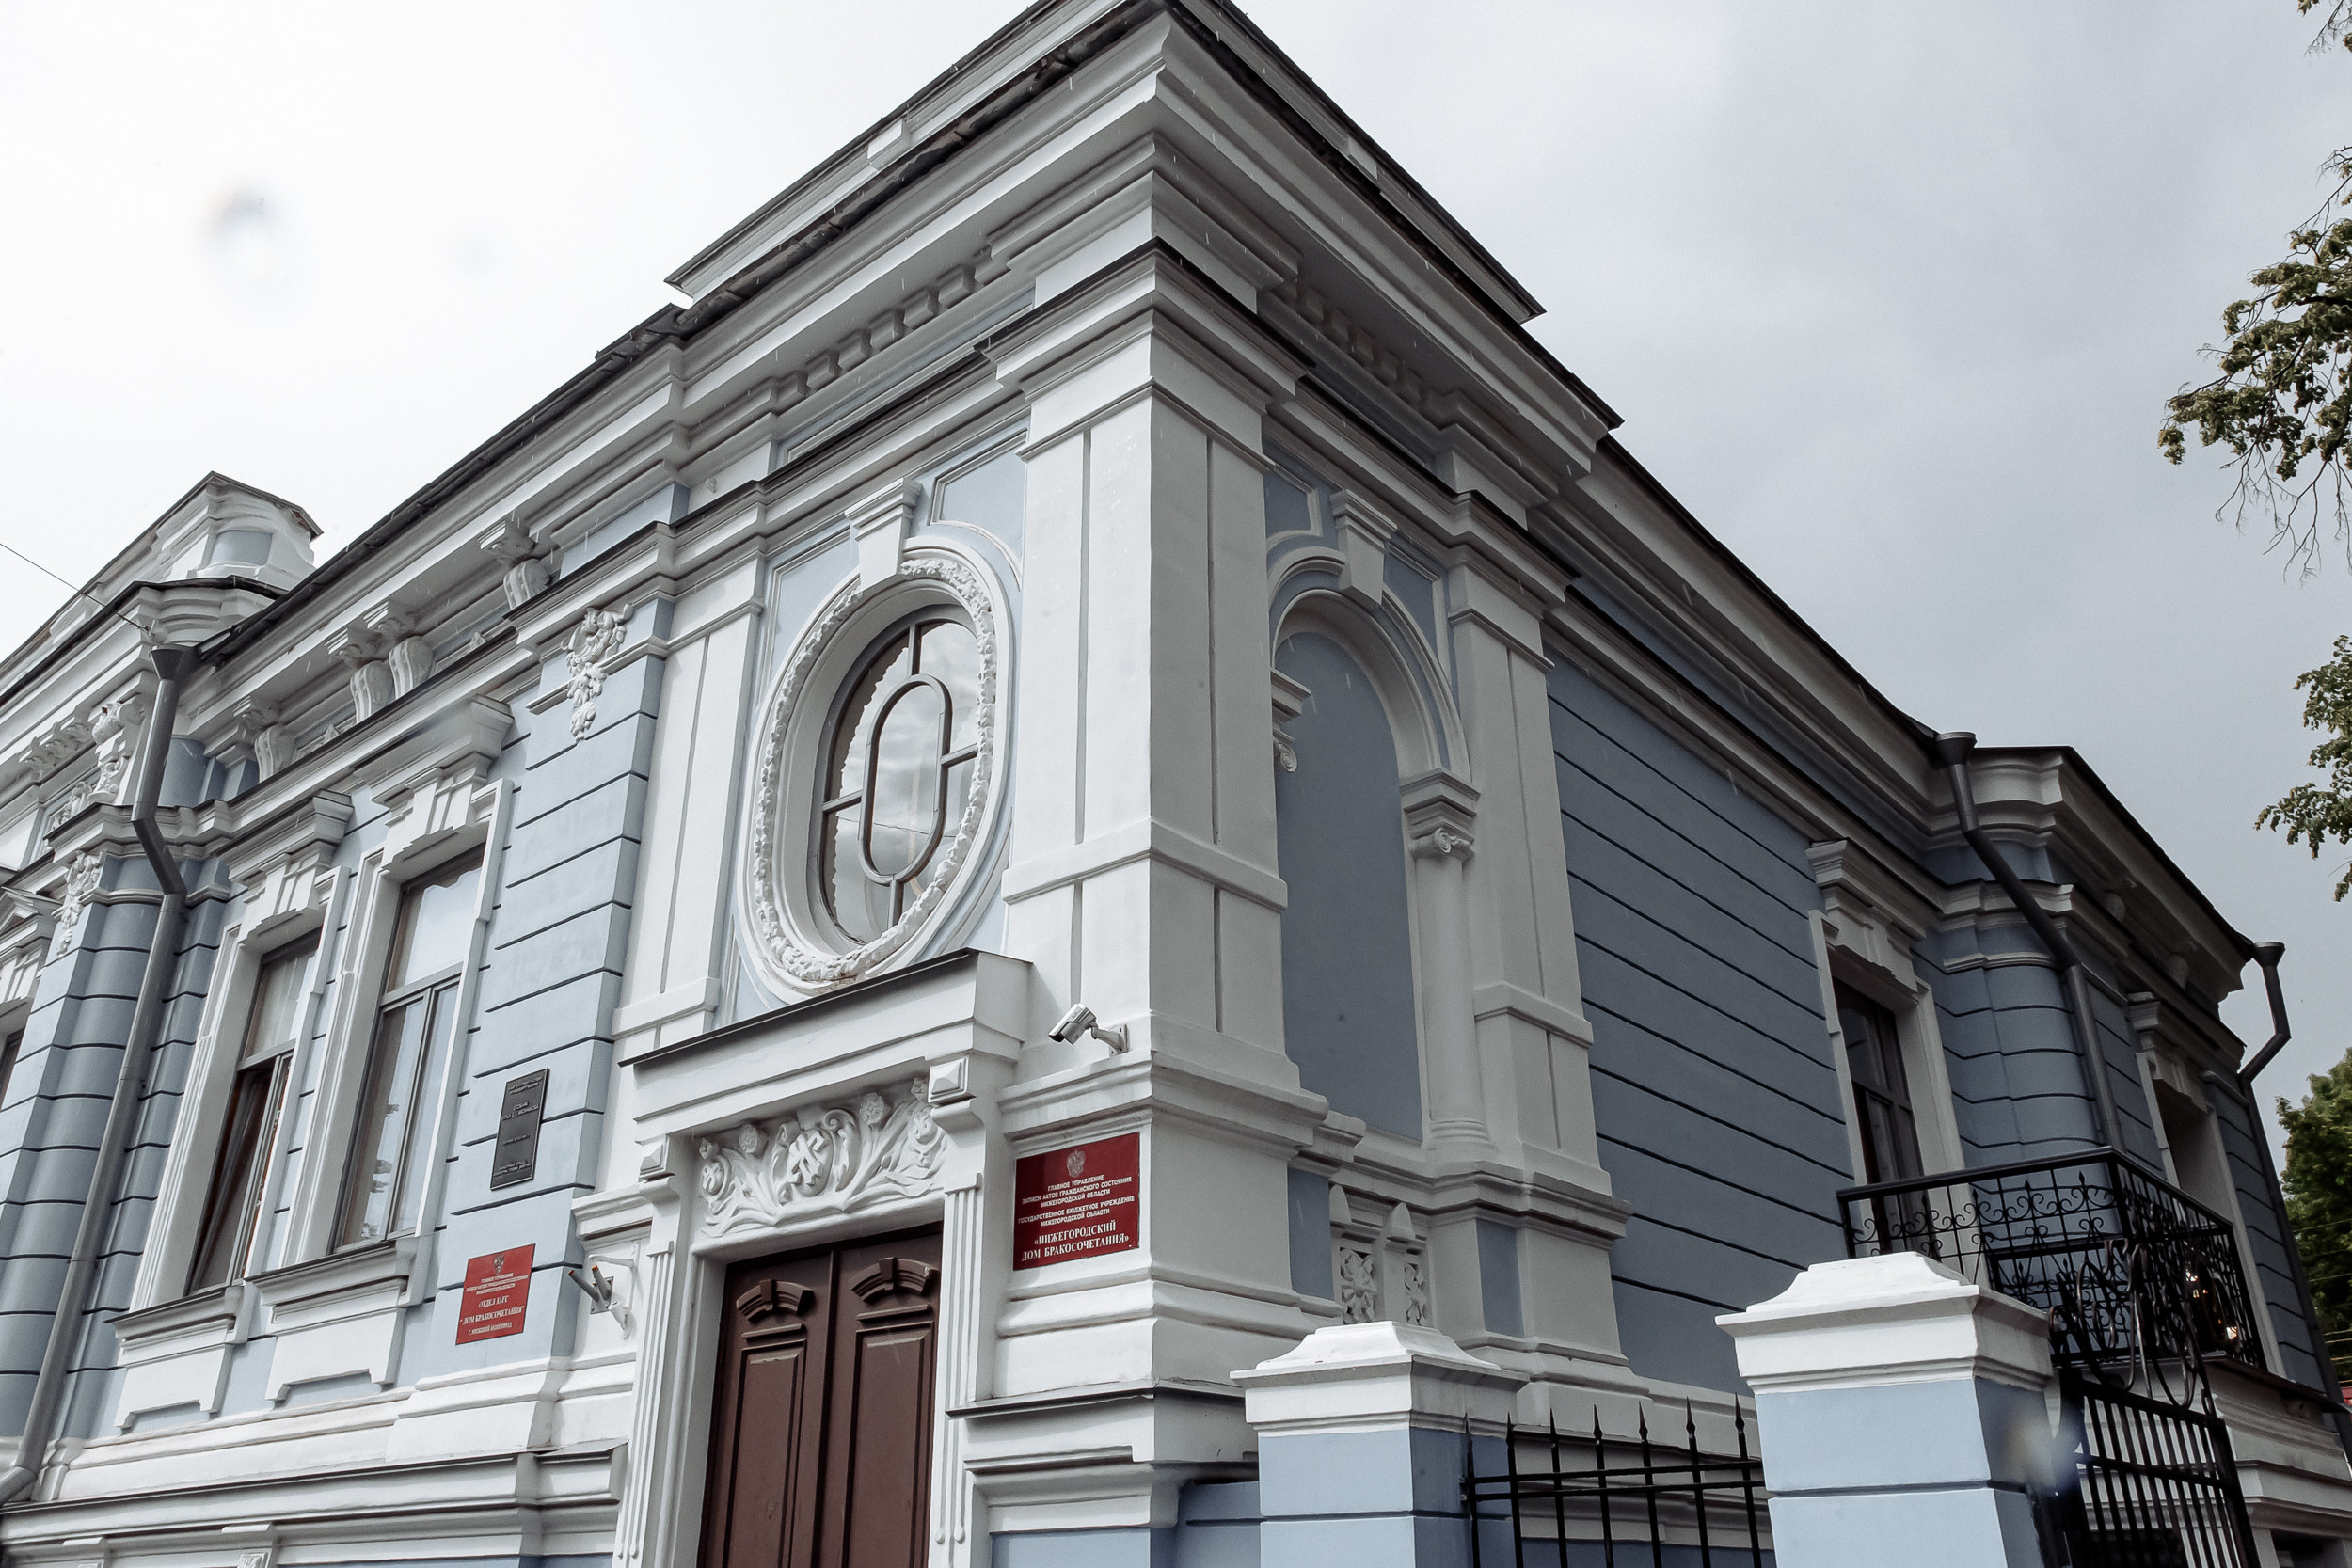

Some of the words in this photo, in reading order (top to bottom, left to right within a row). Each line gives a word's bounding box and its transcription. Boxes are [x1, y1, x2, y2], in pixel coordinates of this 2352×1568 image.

[1022, 1196, 1041, 1204] ЗАПИСИ
[1042, 1191, 1058, 1200] АКТОВ
[1059, 1183, 1100, 1196] ГРАЖДАНСКОГО
[1101, 1177, 1132, 1188] СОСТОЯНИЯ
[1048, 1182, 1071, 1191] ГЛАВНОЕ
[1072, 1175, 1104, 1187] УПРАВЛЕНИЕ
[1018, 1209, 1065, 1224] ГОСУДАРСТВЕННОЕ
[1066, 1203, 1099, 1214] БЮДЖЕТНОЕ
[1100, 1196, 1135, 1208] УЧРЕЖДЕНИЕ
[1041, 1193, 1085, 1208] НИЖЕГОРОДСКОЙ
[1087, 1188, 1111, 1198] ОБЛАСТИ
[1041, 1212, 1085, 1227] НИЖЕГОРОДСКОЙ
[1086, 1208, 1110, 1218] ОБЛАСТИ
[1035, 1219, 1117, 1245] «НИЖЕГОРОДСКИЙ
[1021, 1249, 1041, 1262] ДОМ
[1044, 1233, 1129, 1258] БРАКОСОЧЕТАНИЯ»
